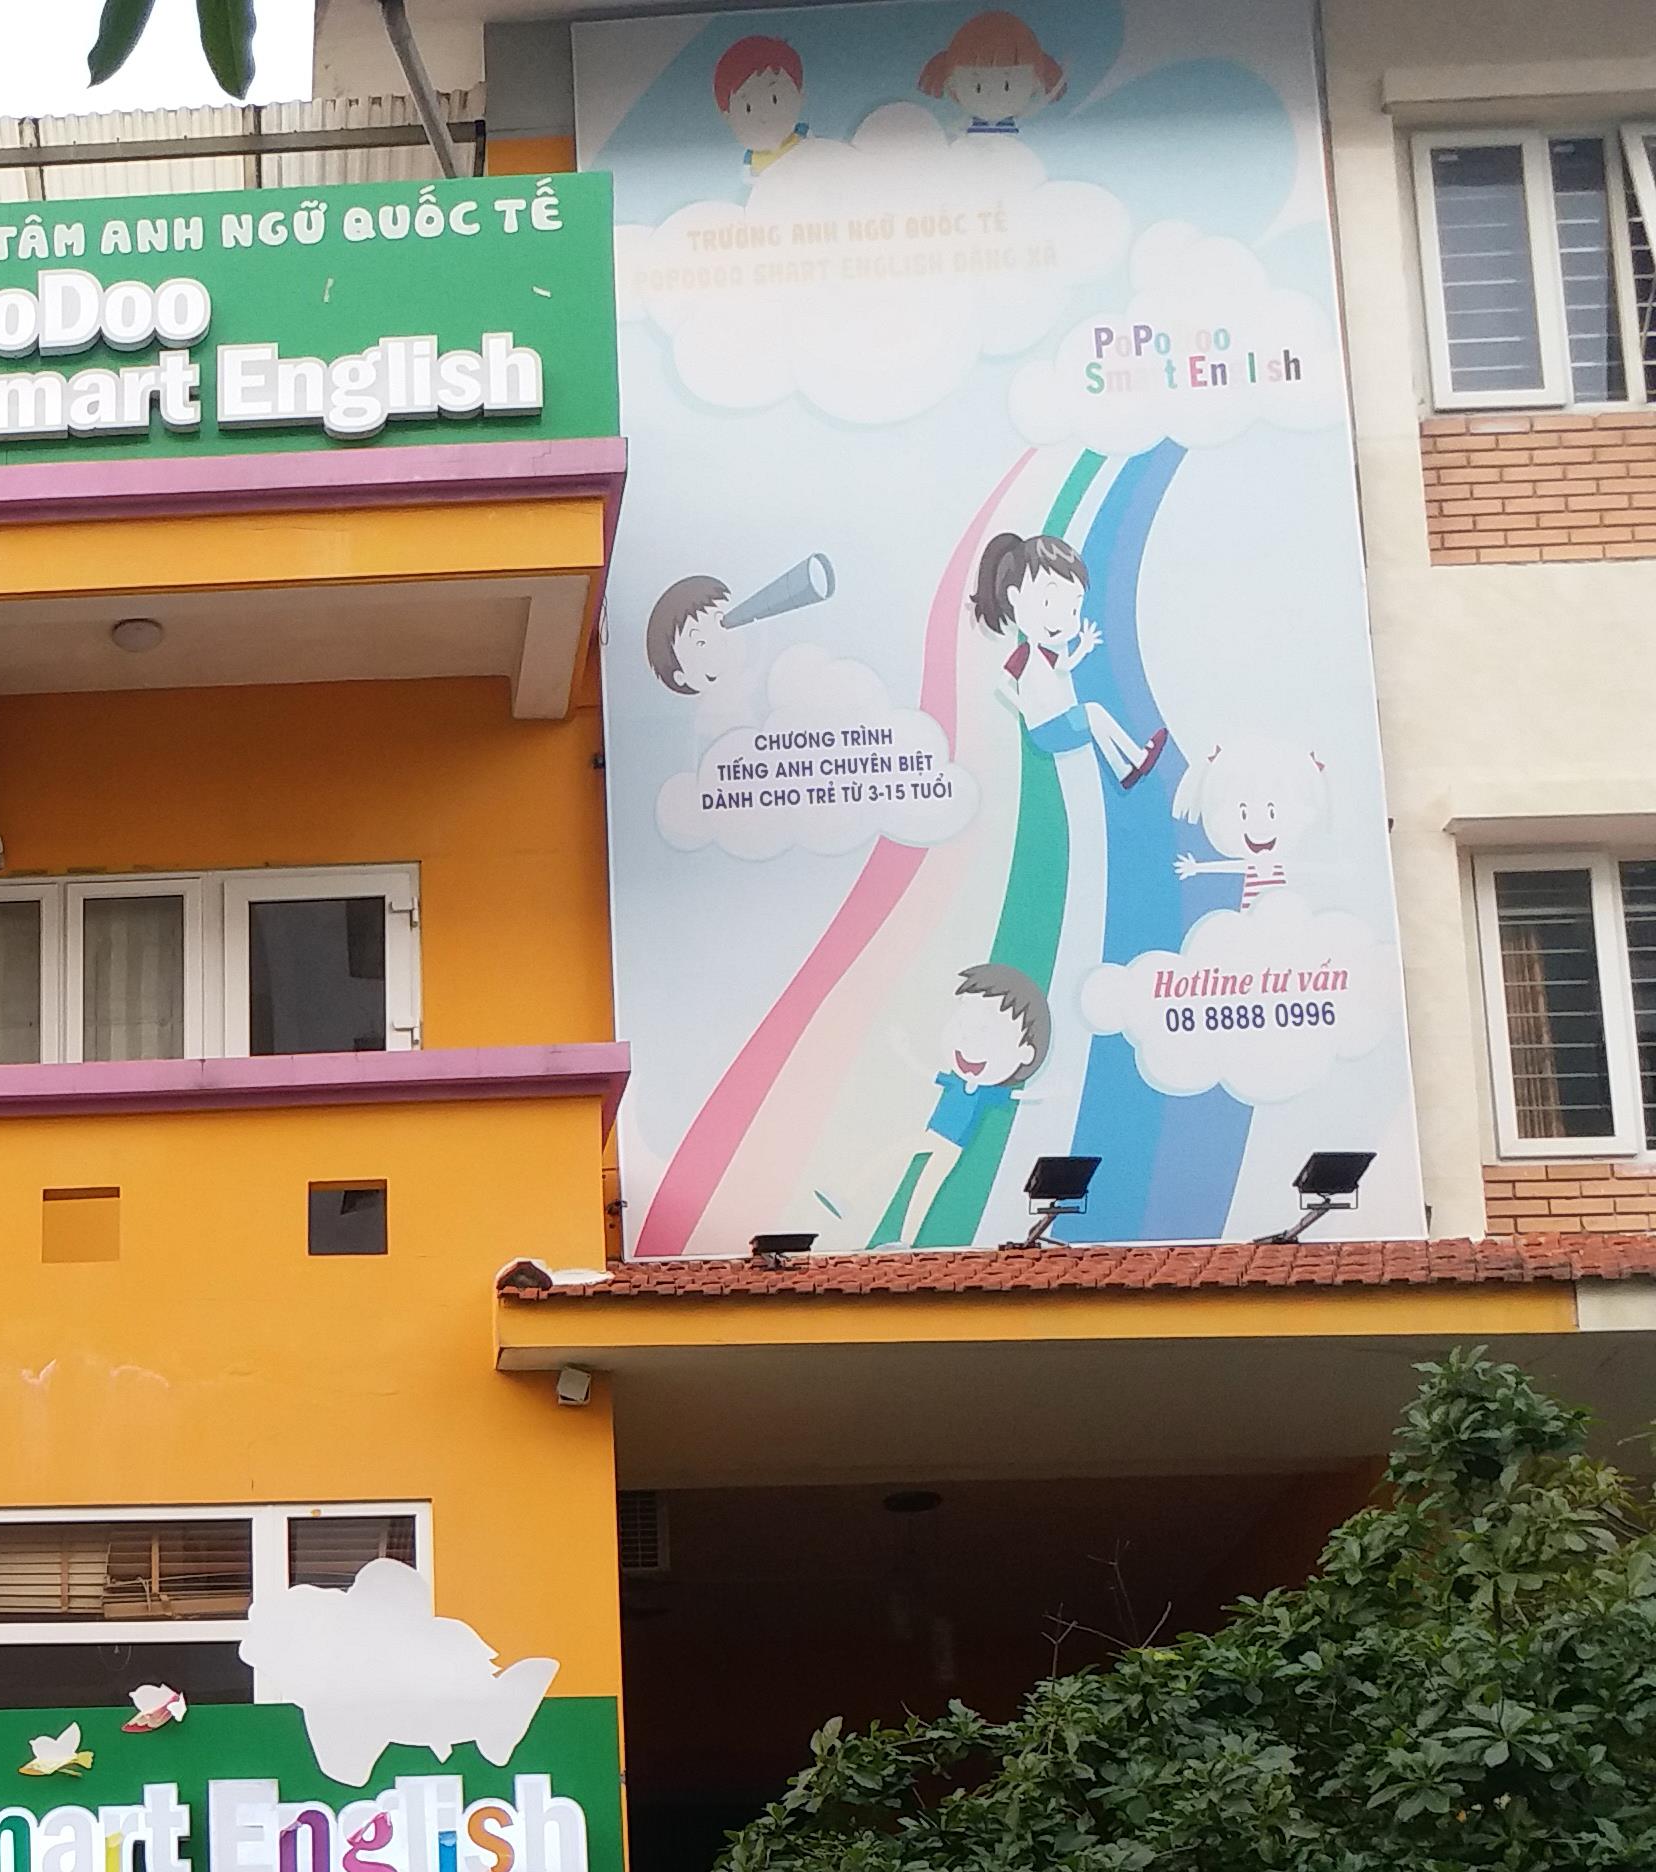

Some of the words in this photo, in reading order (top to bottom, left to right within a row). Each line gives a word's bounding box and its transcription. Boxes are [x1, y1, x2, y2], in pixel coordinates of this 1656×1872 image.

[100, 216, 205, 256] ANH
[221, 201, 327, 249] NGỮ
[343, 184, 481, 241] QUỐC
[494, 178, 566, 234] TẾ
[216, 332, 545, 441] English
[754, 730, 836, 751] CHƯƠNG
[840, 724, 894, 748] TRÌNH
[717, 756, 769, 782] TIẾNG
[775, 760, 814, 779] ANH
[819, 752, 893, 777] CHUYÊN
[898, 750, 934, 777] BIỆT
[701, 788, 753, 811] DÀNH
[759, 788, 802, 808] CHO
[806, 780, 836, 805] TRẺ
[840, 781, 864, 803] TỪ
[868, 782, 906, 802] 3-15
[911, 773, 953, 800] TUỔI
[1153, 967, 1254, 999] Hotline
[1260, 966, 1292, 994] tư
[1297, 958, 1349, 994] vấn
[1165, 1007, 1196, 1033] 08
[1205, 1004, 1266, 1031] 8888
[1274, 1001, 1336, 1028] 0996
